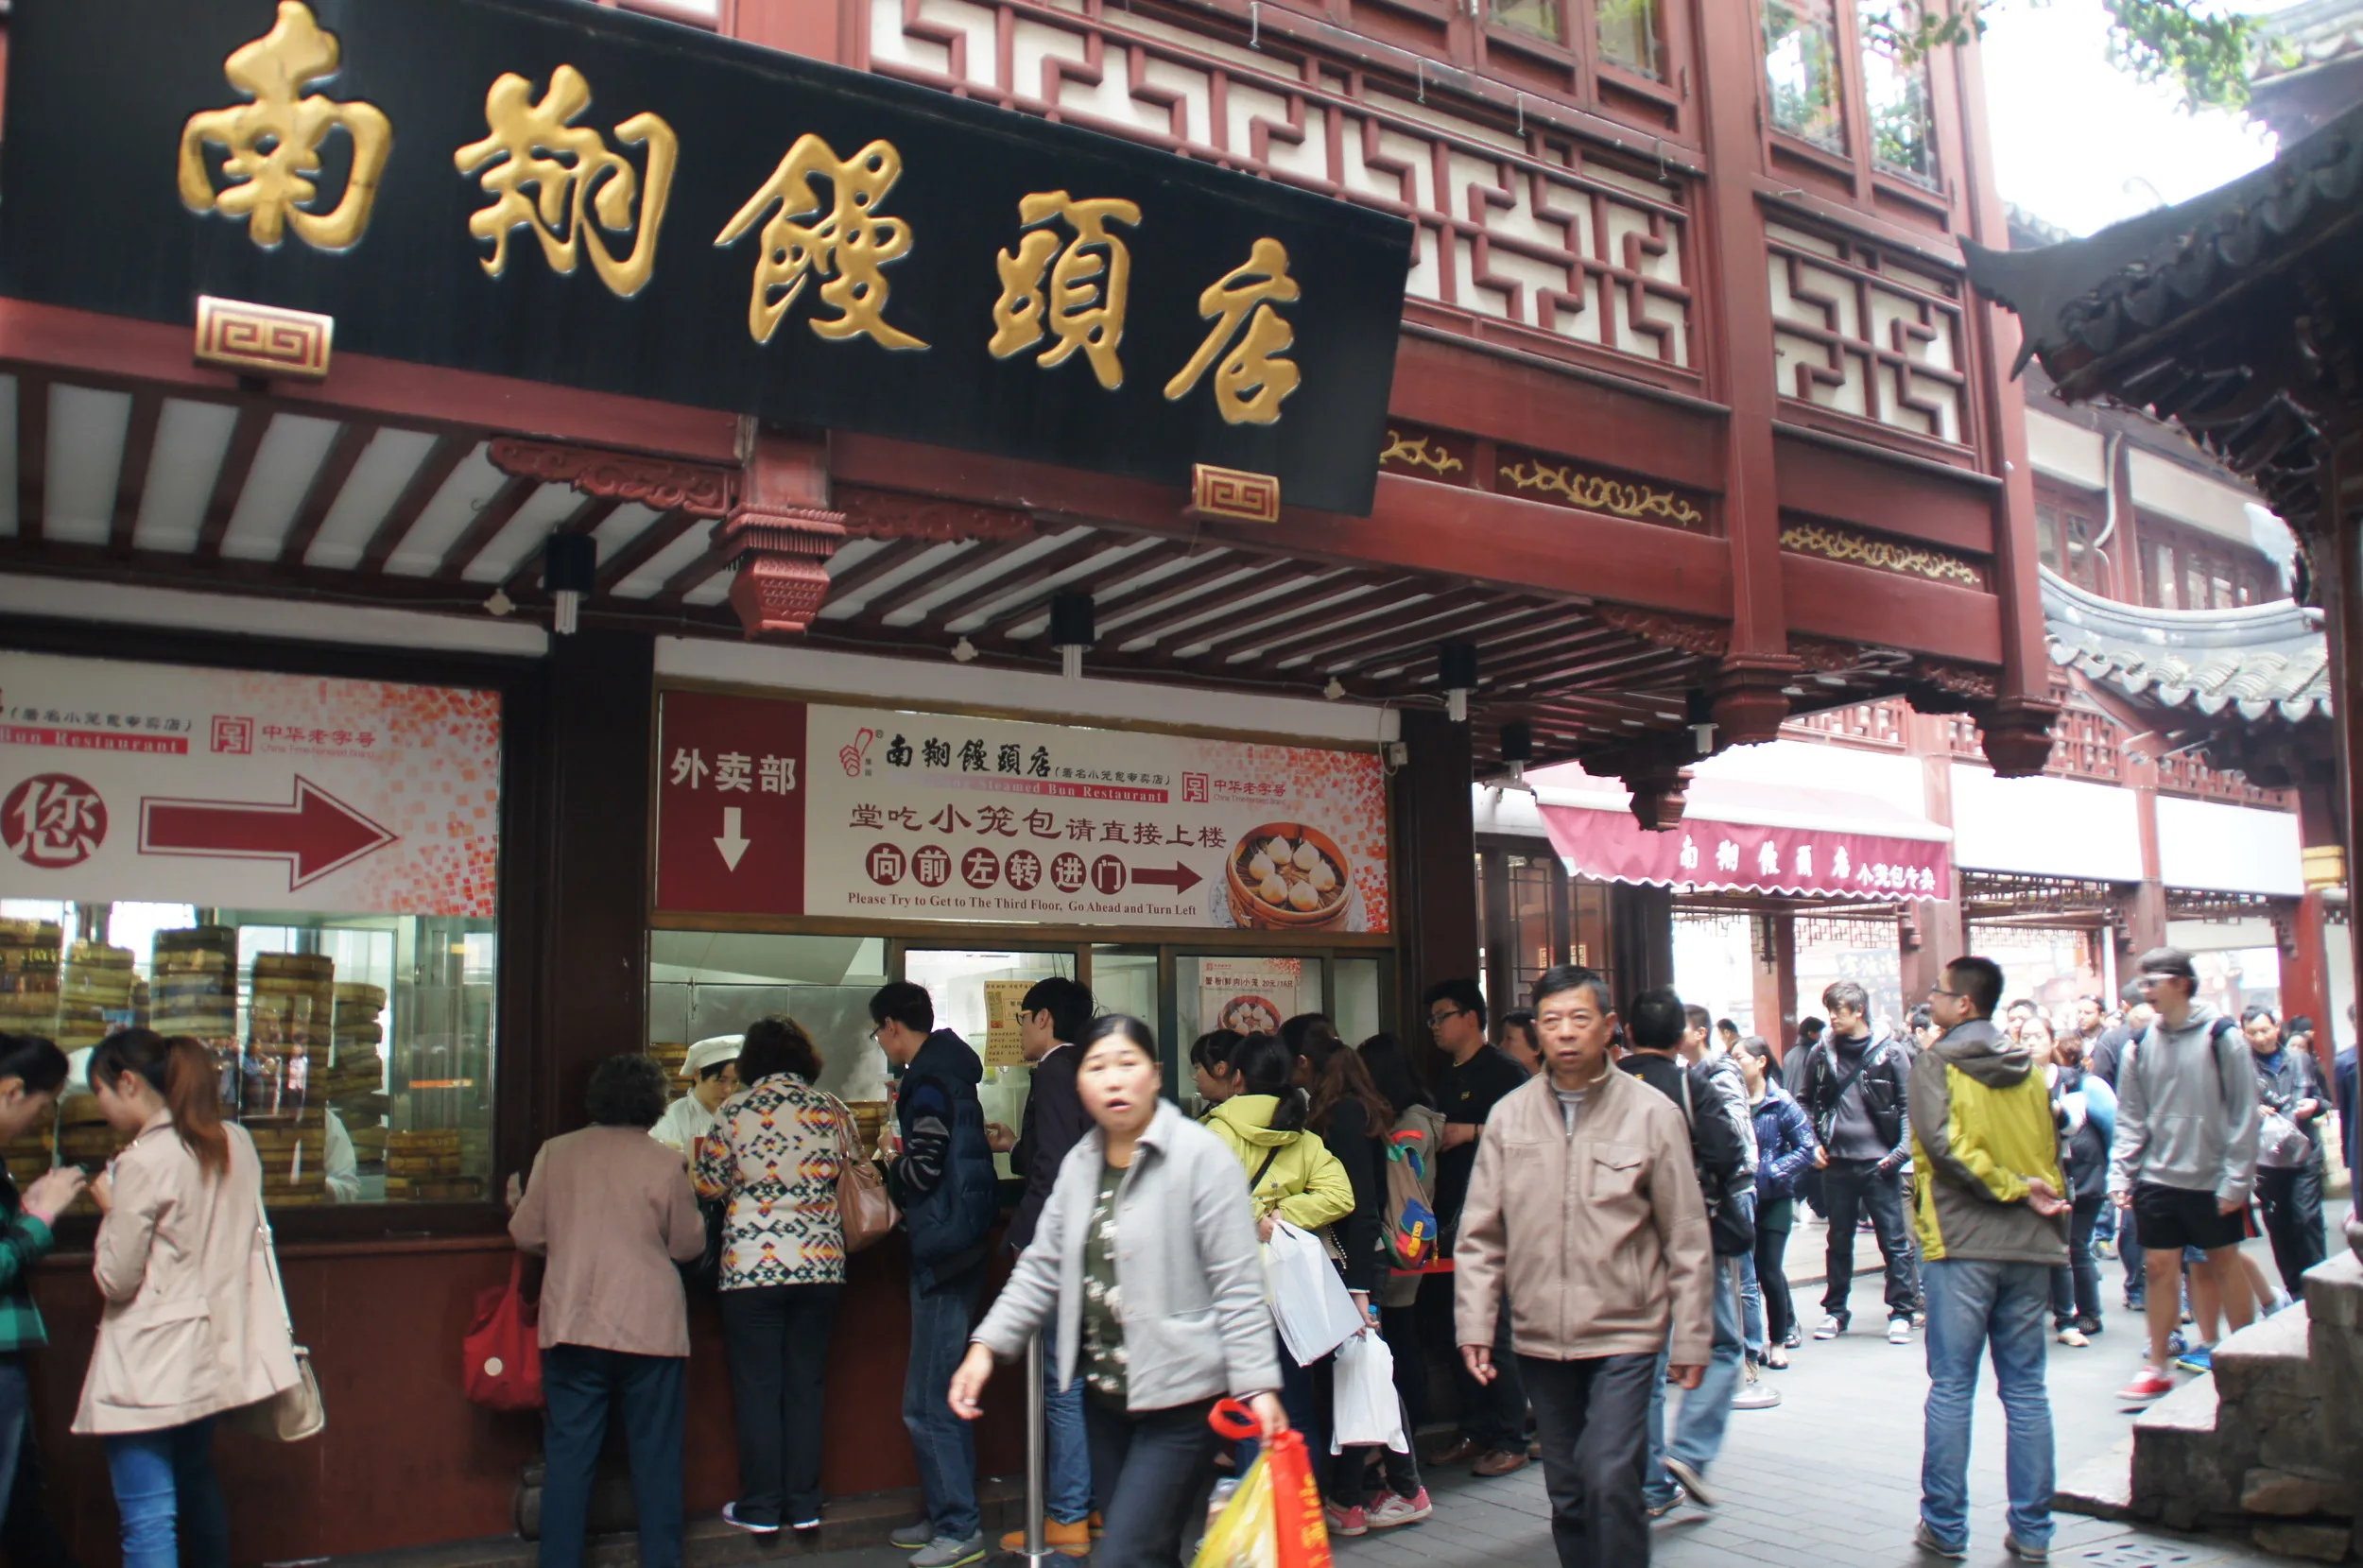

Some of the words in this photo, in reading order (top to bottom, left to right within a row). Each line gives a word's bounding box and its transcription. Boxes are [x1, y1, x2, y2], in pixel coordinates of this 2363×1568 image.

[56, 731, 178, 753] Restaurant
[263, 724, 375, 748] 中华老字号
[670, 748, 796, 795] 外卖部
[979, 780, 1040, 793] Steamed
[1048, 784, 1075, 796] Bun
[1083, 785, 1162, 801] Restaurant
[1214, 780, 1286, 797] 中华老字号
[13, 779, 99, 863] 您
[849, 803, 1227, 849] 堂吃小笼包请直接上楼
[871, 847, 1123, 890] 向前左转进门
[848, 892, 887, 905] Please
[889, 894, 910, 907] Try
[915, 894, 926, 905] to
[930, 895, 951, 906] Get
[955, 896, 966, 907] to
[969, 897, 992, 908] The
[994, 898, 1027, 909] Third
[1030, 899, 1063, 912] Floor,
[1068, 901, 1084, 912] Go
[1086, 901, 1121, 913] Ahead
[1124, 903, 1144, 914] and
[1146, 904, 1172, 915] Turn
[1175, 904, 1197, 916] Left
